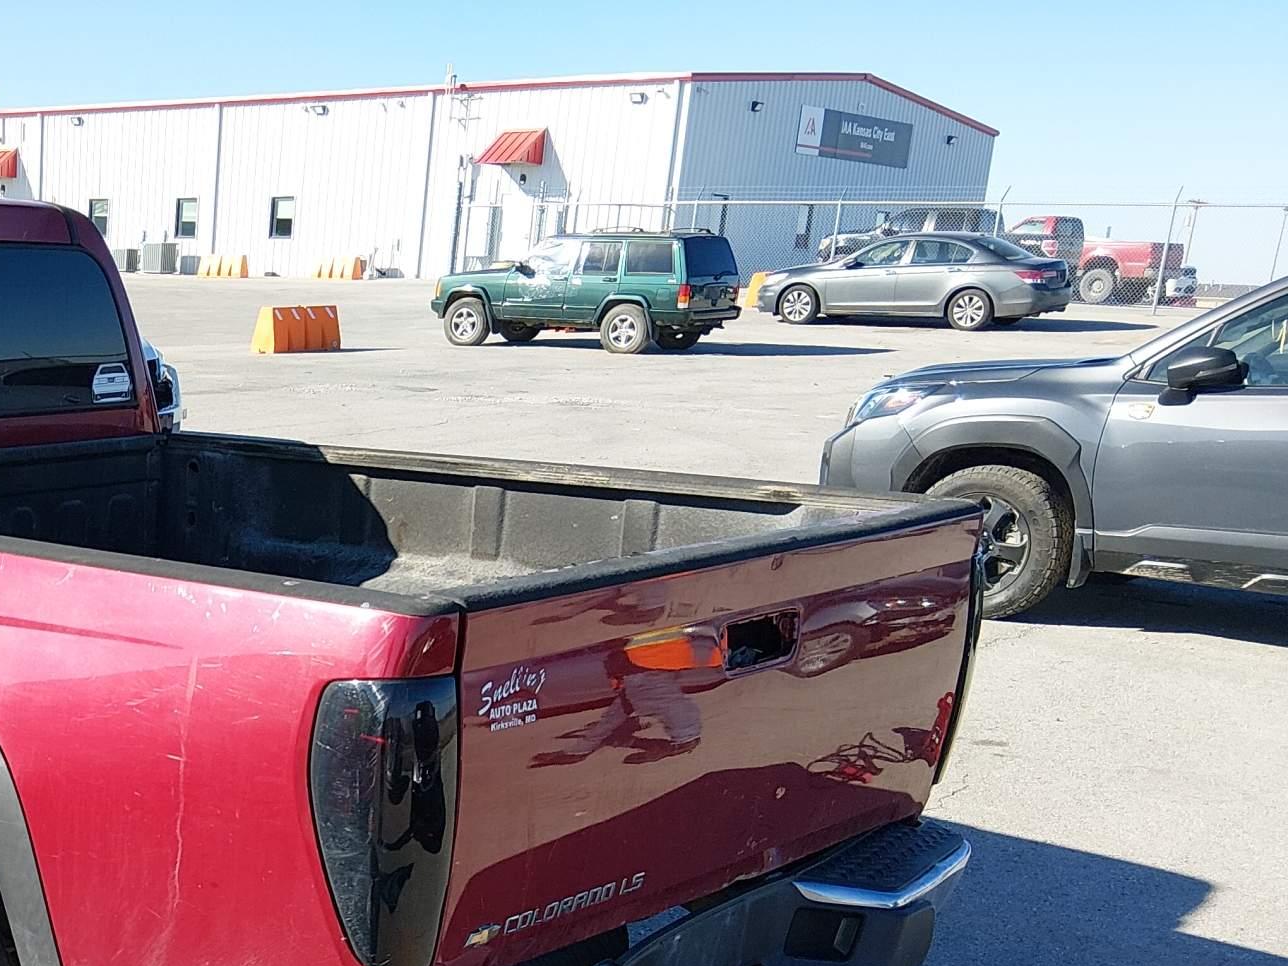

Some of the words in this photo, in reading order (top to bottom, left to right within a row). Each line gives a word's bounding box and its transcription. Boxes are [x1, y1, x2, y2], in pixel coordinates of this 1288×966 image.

[872, 125, 884, 142] City
[489, 704, 511, 721] AUTO
[512, 698, 538, 715] PLAZA
[525, 714, 537, 724] MO
[503, 881, 617, 935] COLORADO
[619, 871, 646, 896] LS
